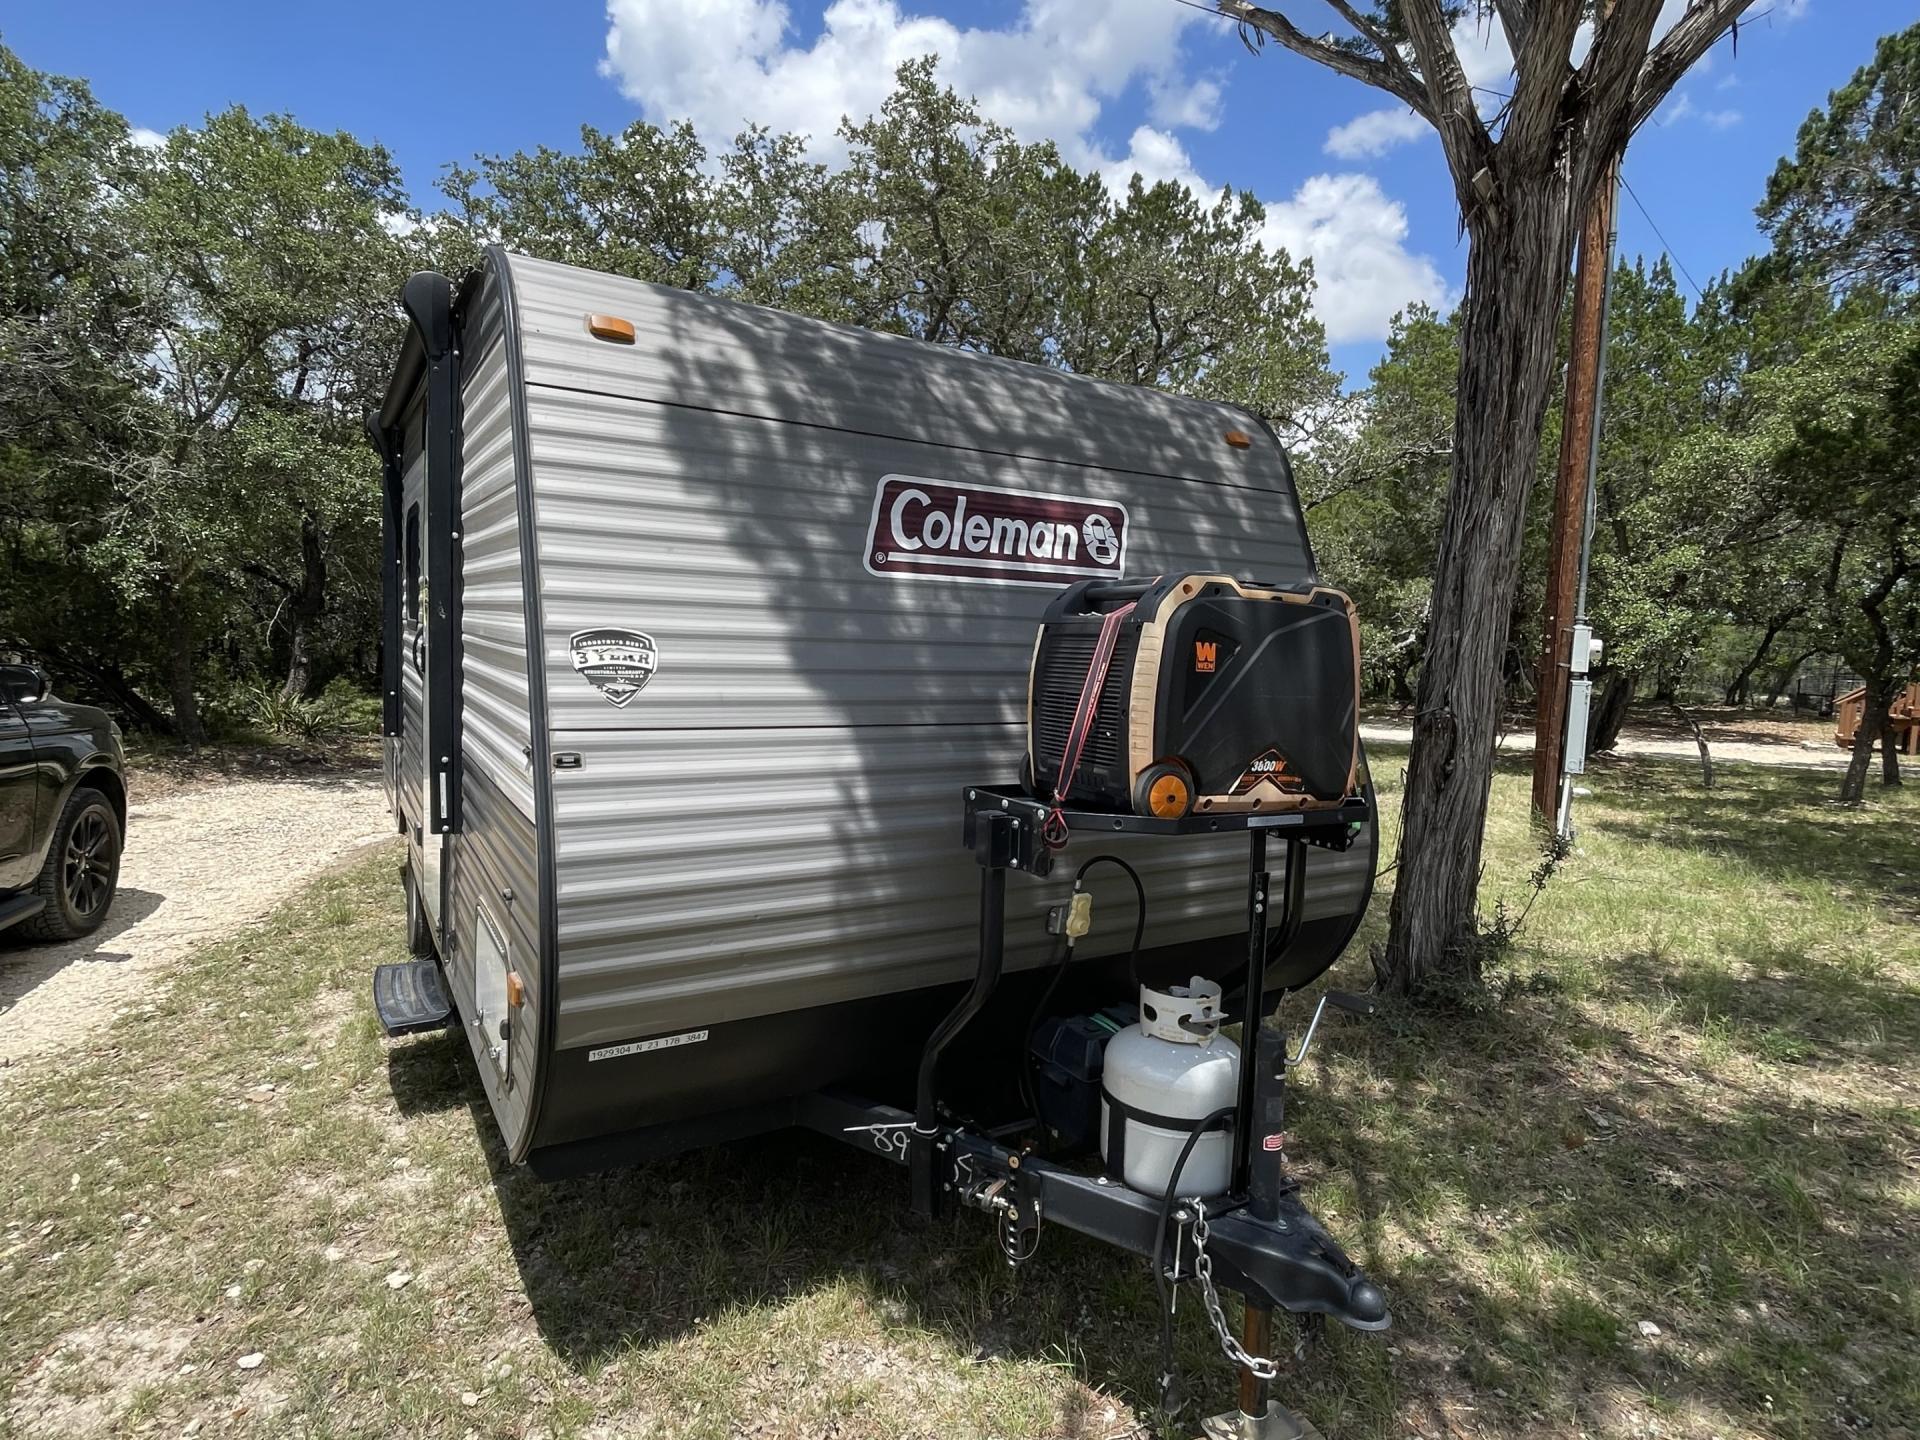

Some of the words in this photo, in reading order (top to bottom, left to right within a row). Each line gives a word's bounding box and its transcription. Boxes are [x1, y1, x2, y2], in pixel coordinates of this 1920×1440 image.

[890, 488, 1078, 560] Coleman
[576, 651, 588, 664] 3
[665, 1037, 680, 1046] 178
